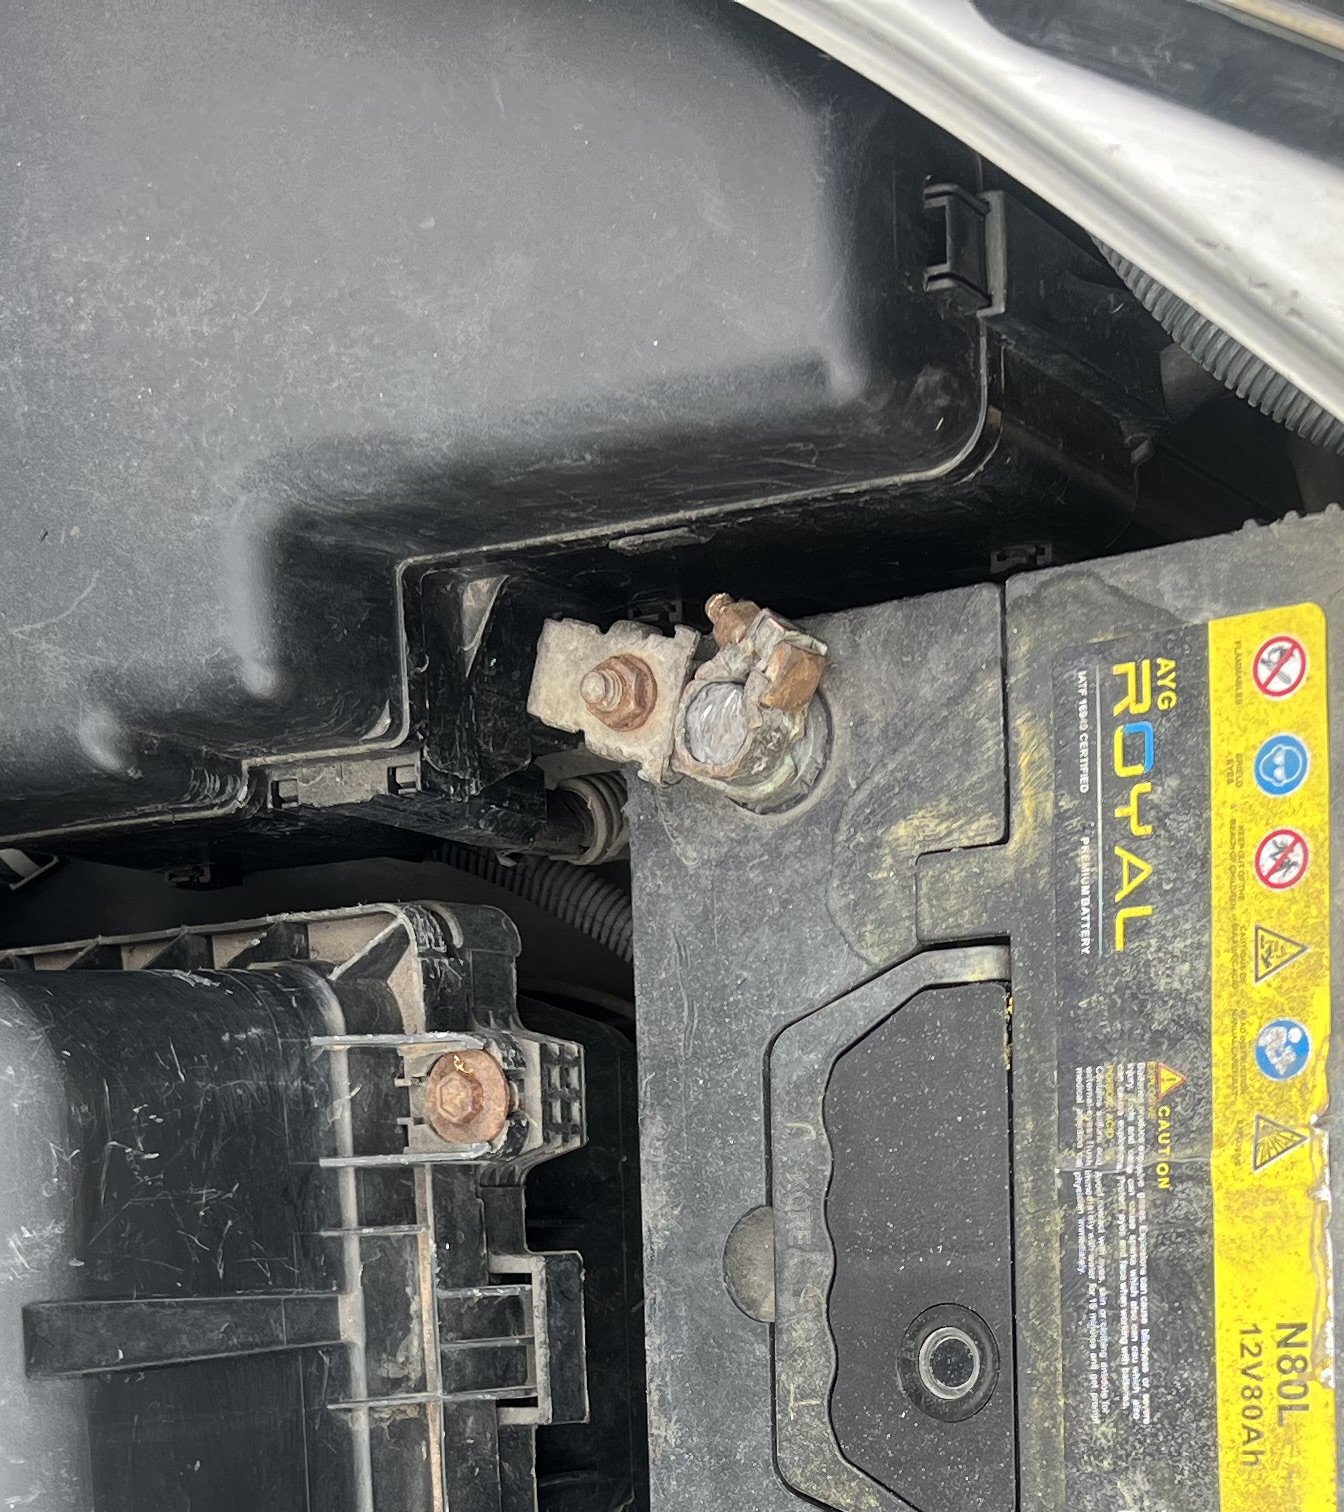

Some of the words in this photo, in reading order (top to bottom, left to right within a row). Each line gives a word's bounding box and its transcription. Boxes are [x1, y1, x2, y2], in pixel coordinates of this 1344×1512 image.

[1155, 657, 1176, 711] AYG
[1078, 733, 1089, 794] CERTIFIED
[1113, 658, 1155, 953] ROYAL
[1156, 1105, 1171, 1189] CAUTON
[1239, 1322, 1265, 1467] 12V80Ah
[1276, 1322, 1309, 1428] N80L
